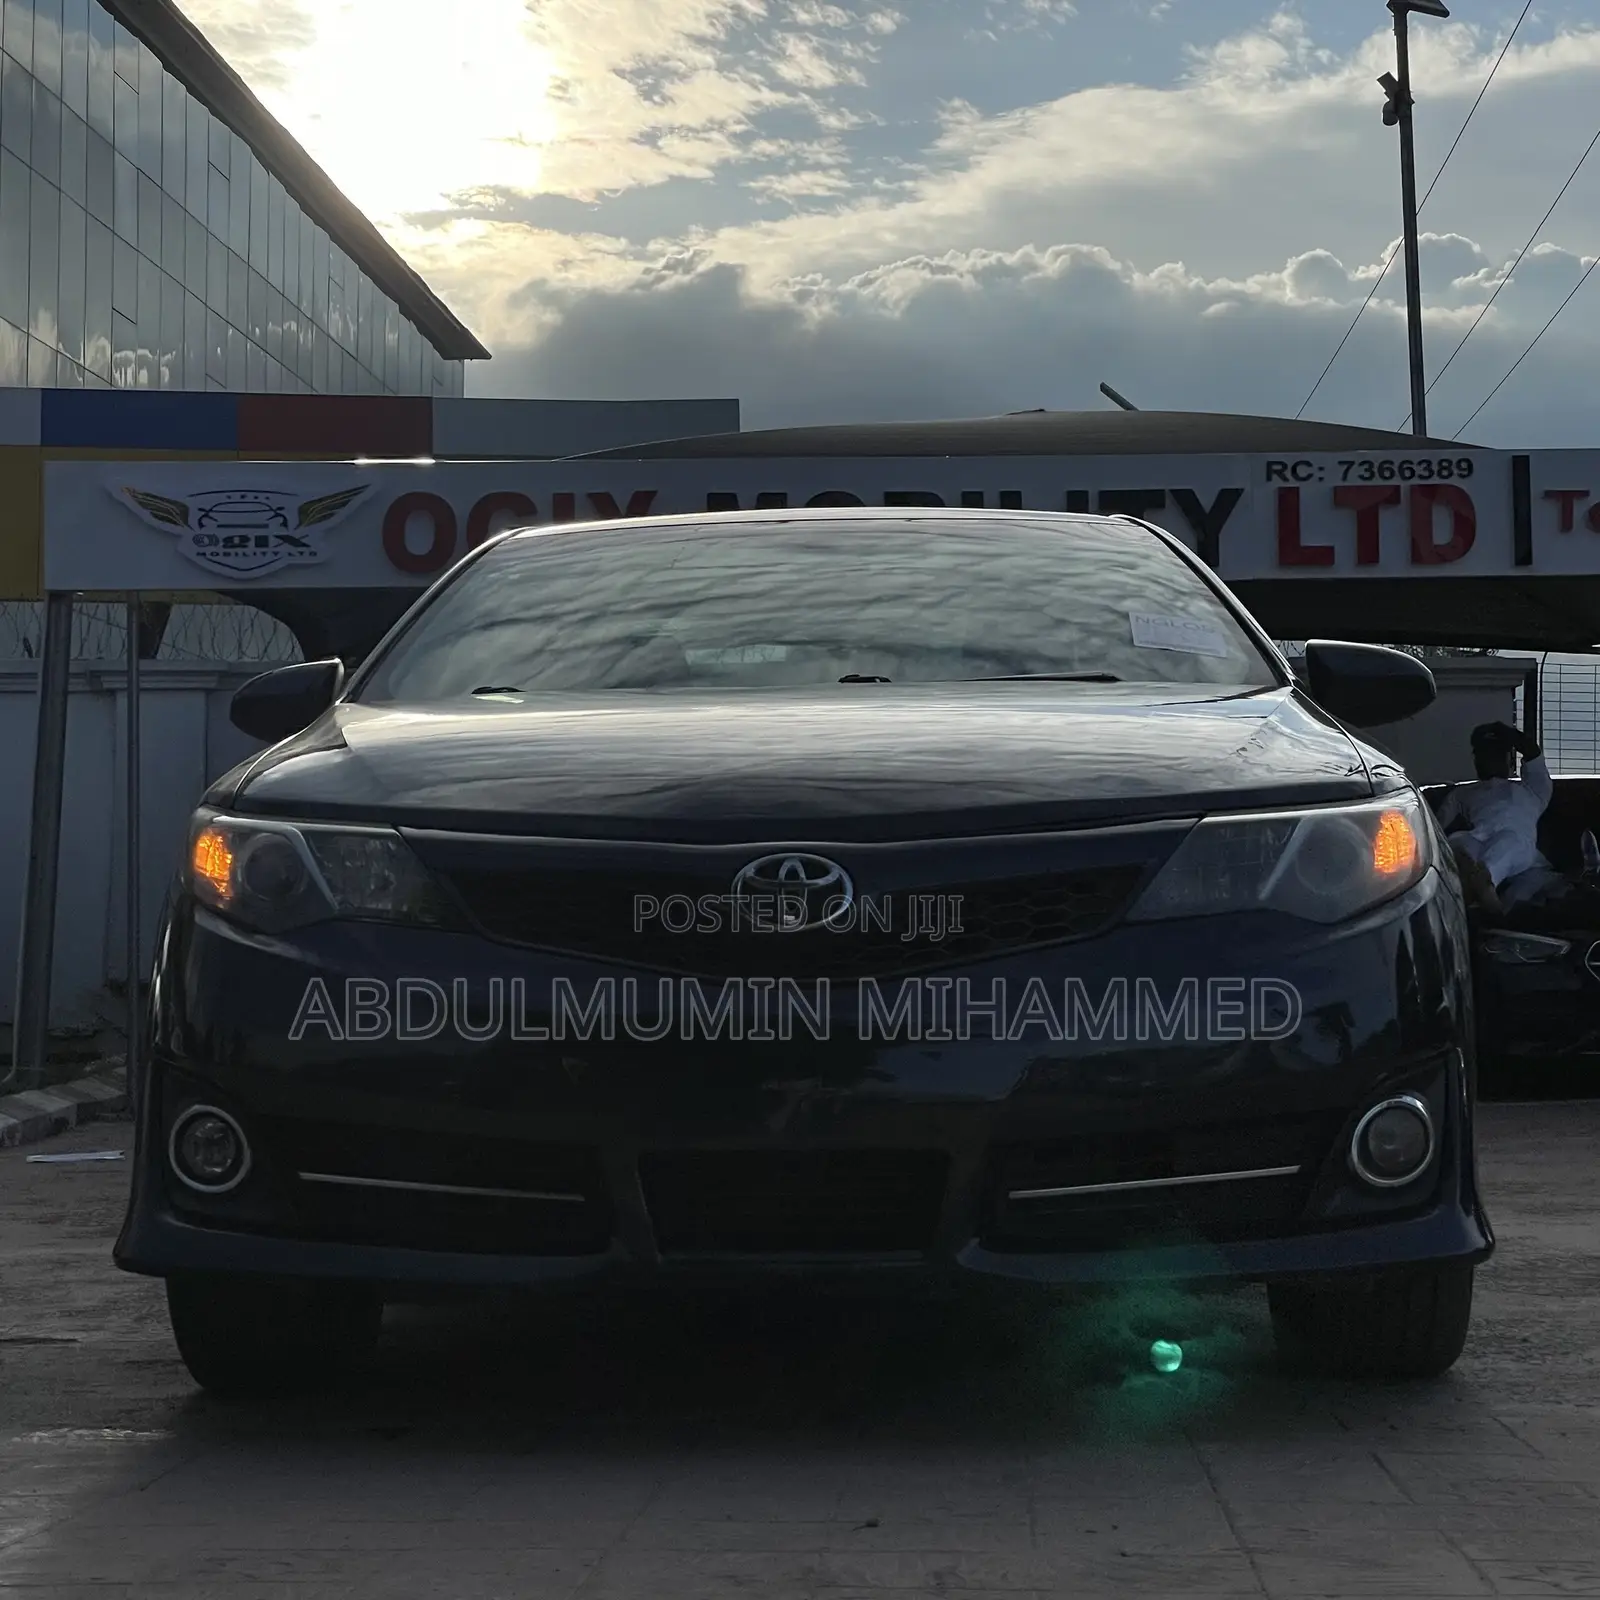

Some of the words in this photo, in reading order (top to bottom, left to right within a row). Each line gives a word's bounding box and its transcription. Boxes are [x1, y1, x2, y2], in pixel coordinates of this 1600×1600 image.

[1265, 460, 1325, 482] RC:
[1337, 457, 1474, 481] 7366389
[1276, 483, 1477, 566] LTD
